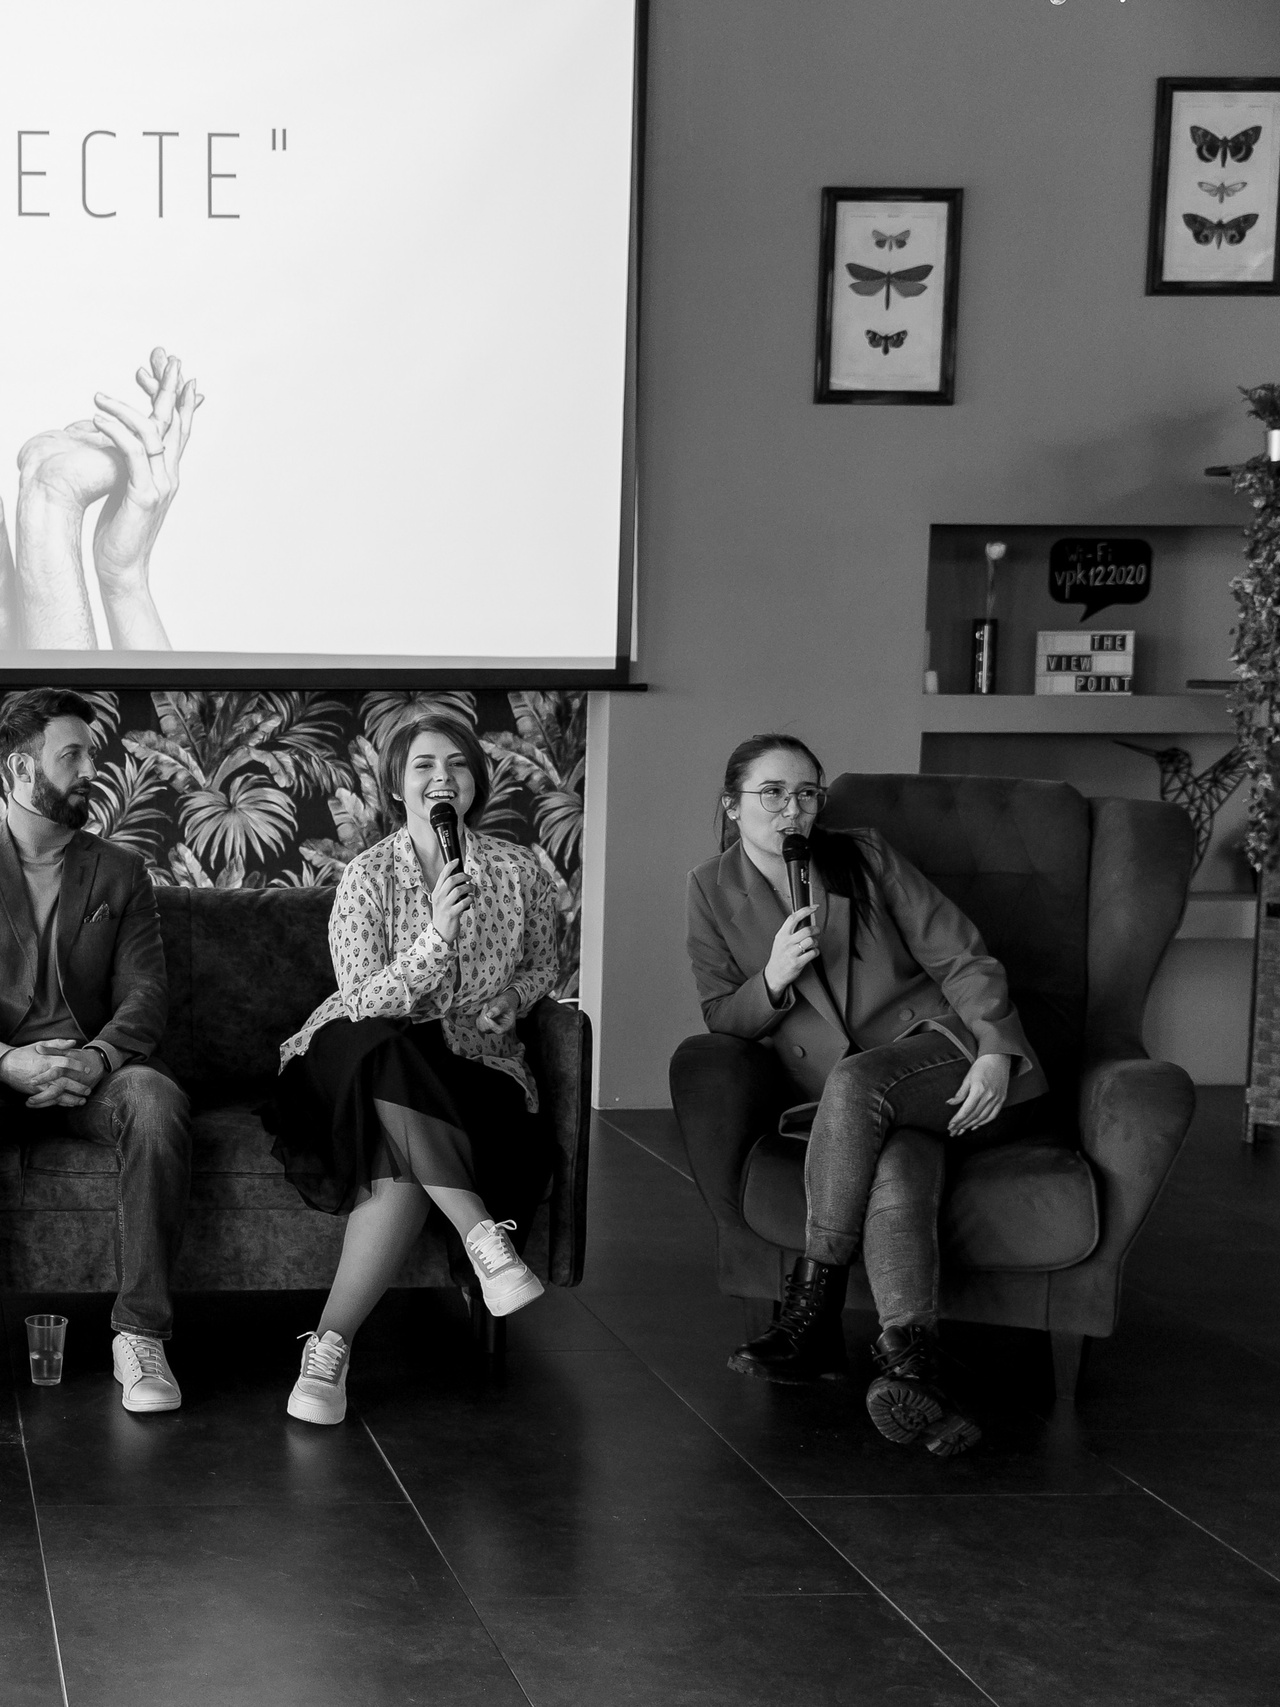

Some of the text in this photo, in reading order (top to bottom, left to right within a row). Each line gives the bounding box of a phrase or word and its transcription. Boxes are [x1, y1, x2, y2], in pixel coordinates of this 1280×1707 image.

[1065, 542, 1112, 561] Wi-Fi
[1055, 563, 1147, 599] vpk122020
[1092, 636, 1124, 651] THE
[1048, 656, 1091, 671] VIEW
[1076, 677, 1132, 692] POINT
